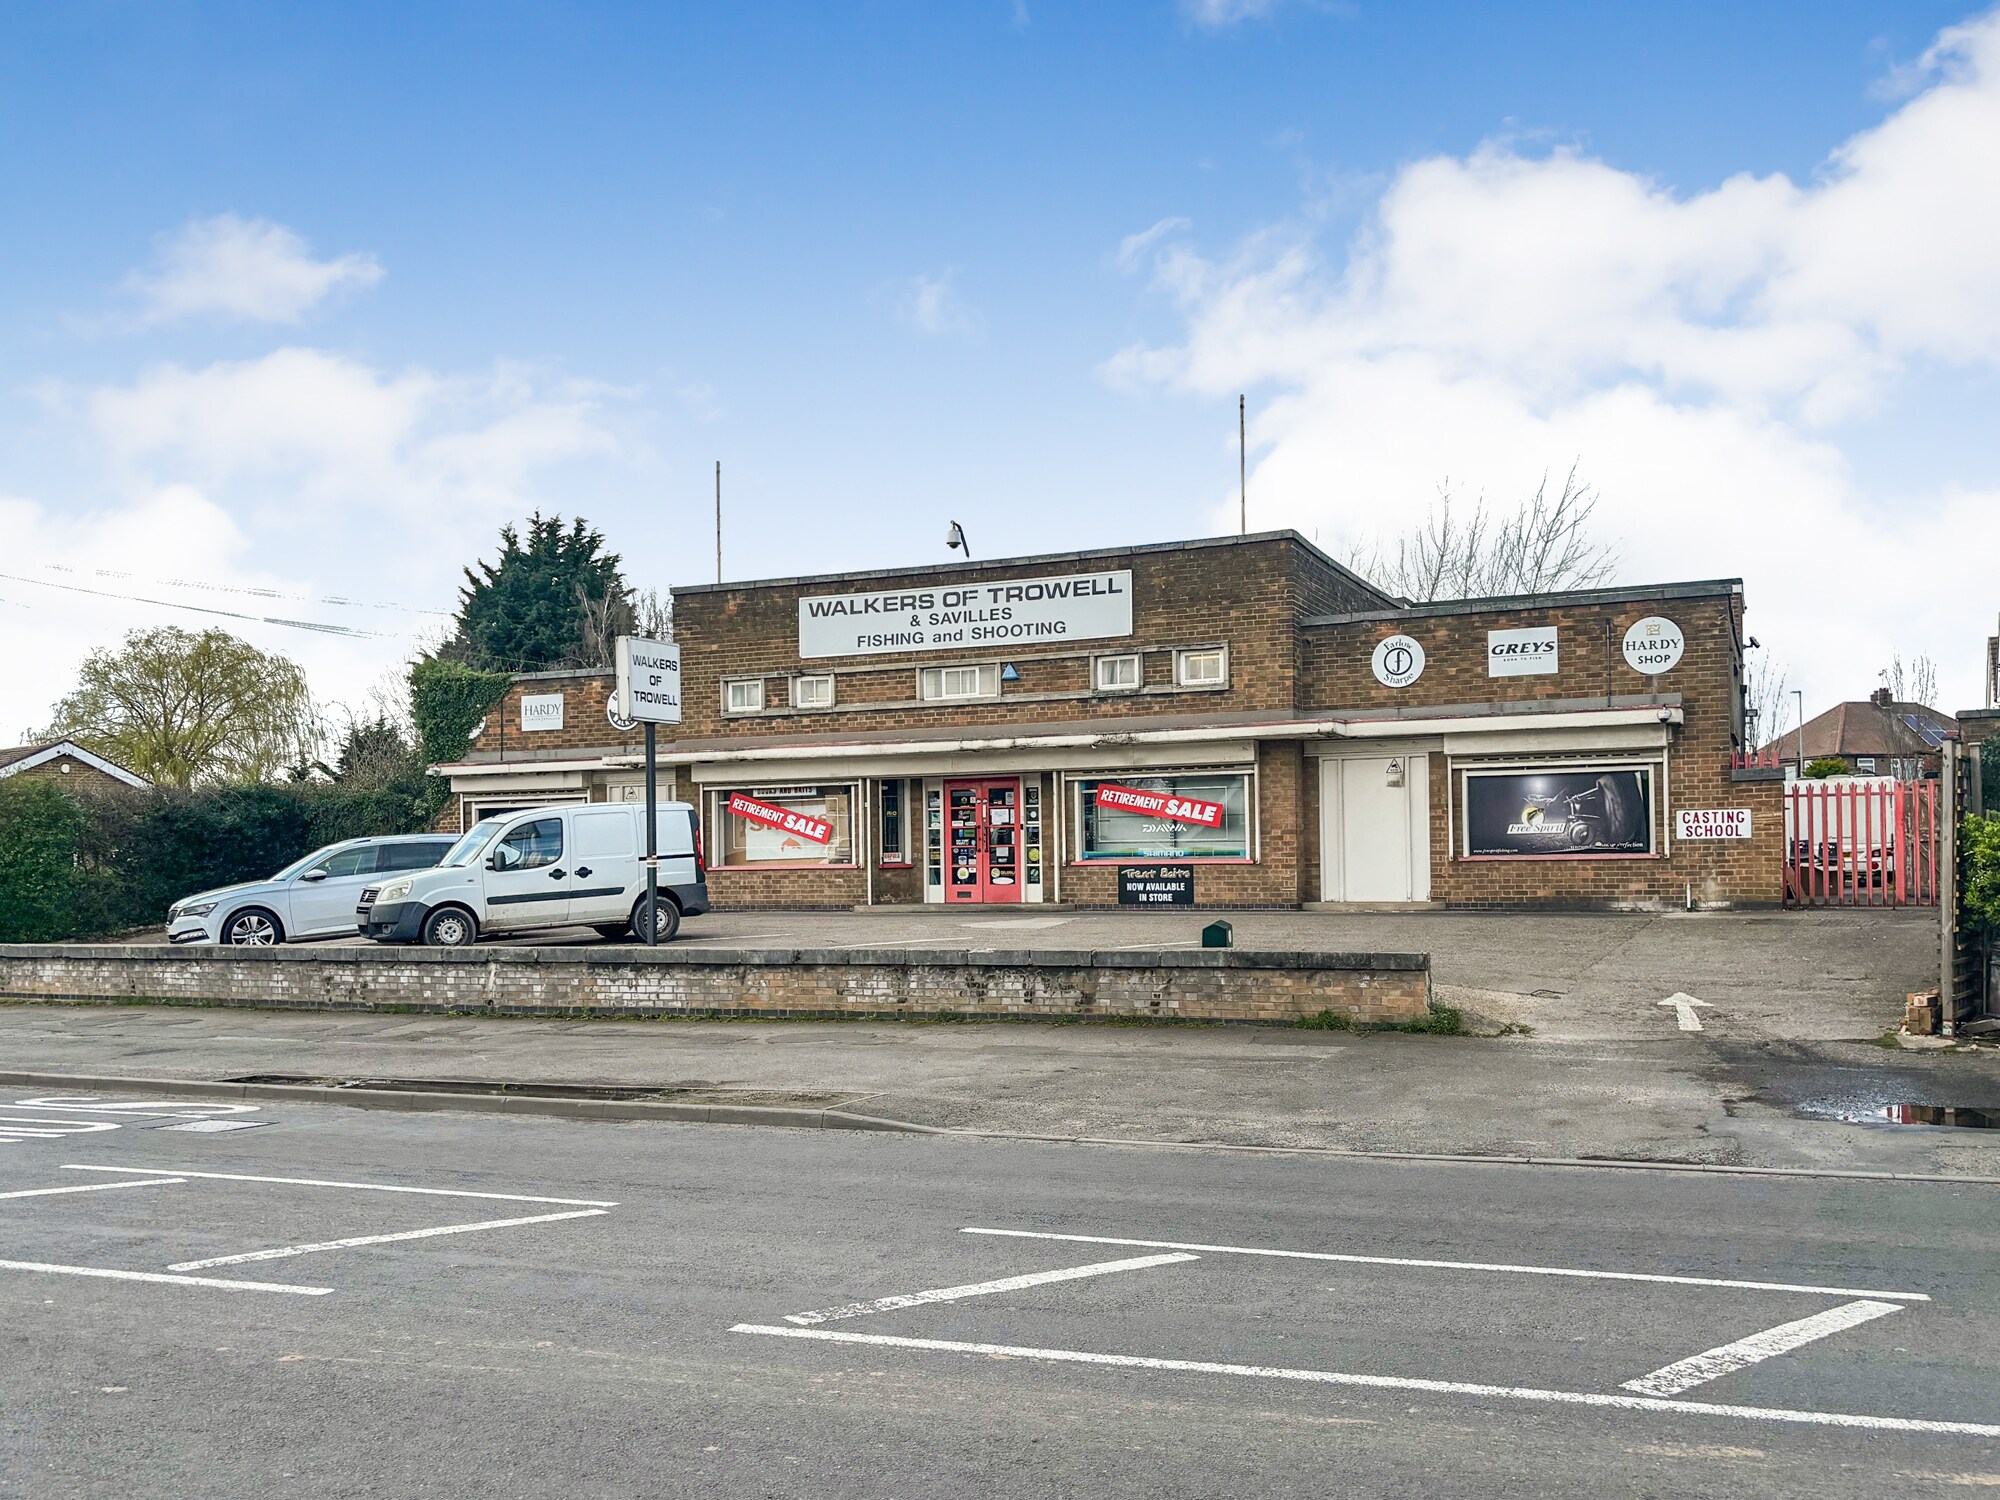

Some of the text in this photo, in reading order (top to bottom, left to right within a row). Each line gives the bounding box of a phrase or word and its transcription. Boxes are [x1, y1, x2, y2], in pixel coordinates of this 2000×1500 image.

[808, 578, 1123, 618] WALKERS OF TROWELL
[910, 607, 1013, 627] & SAVILLES
[857, 621, 1066, 648] FISHING and SHOOTING
[1383, 638, 1413, 651] Farlow
[1491, 640, 1556, 656] GREYS
[1625, 638, 1681, 651] HARDY
[632, 654, 678, 671] WALKERS
[1637, 654, 1671, 664] SHOP
[649, 675, 662, 687] OF
[1383, 673, 1414, 684] Sharpe
[633, 690, 678, 706] TROWELL
[524, 703, 561, 716] HARDY
[1100, 789, 1217, 822] RETIREMENT SALE
[732, 798, 785, 823] RETIREMENT
[784, 814, 827, 839] SALE
[1682, 811, 1745, 824] CASTING
[1510, 824, 1564, 833] Free Spirit
[1686, 824, 1742, 837] SCHOOL
[1143, 849, 1184, 858] SHIMANO
[1121, 867, 1191, 879] Trent Baits
[1126, 882, 1185, 891] NOW AVAILABLE
[1139, 893, 1173, 902] IN STORE
